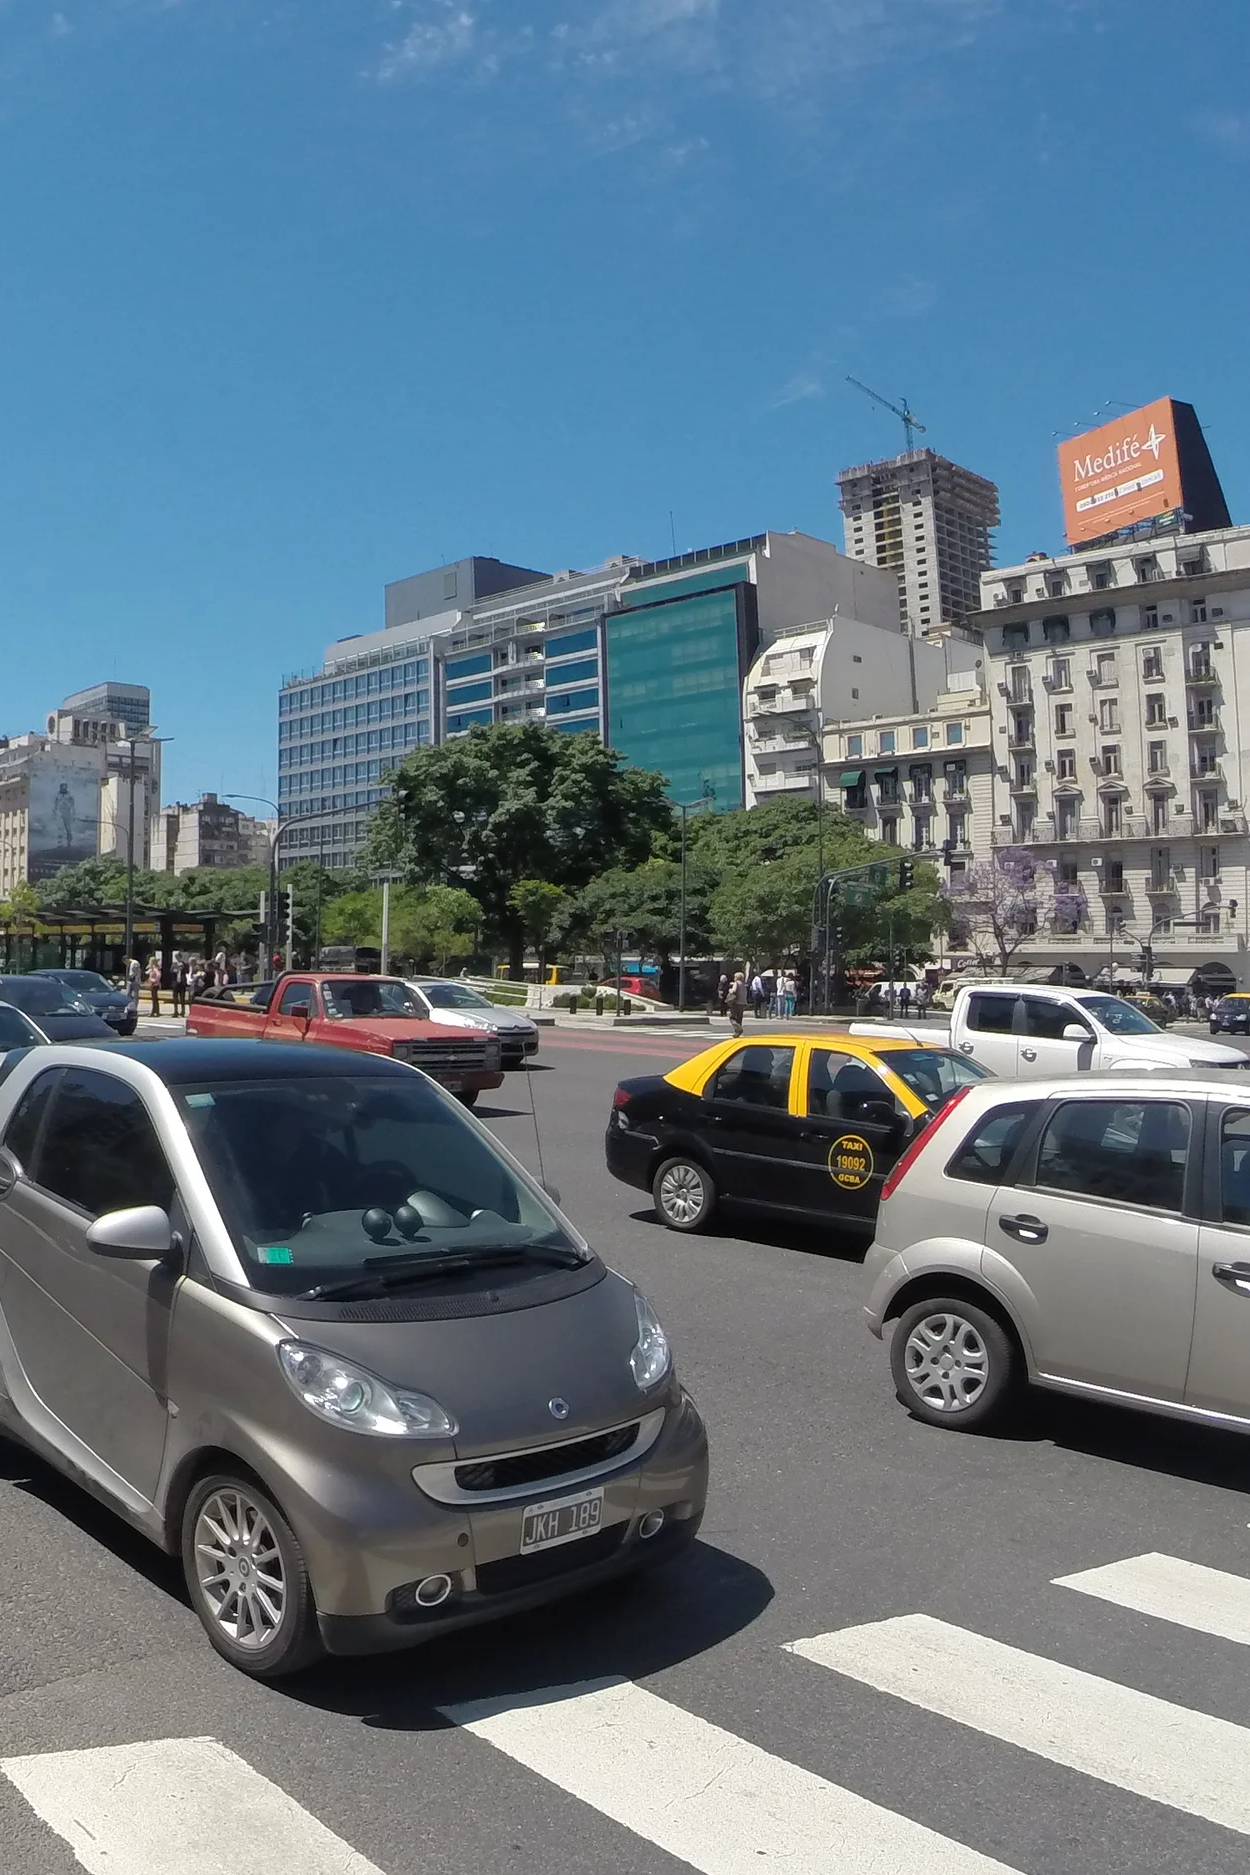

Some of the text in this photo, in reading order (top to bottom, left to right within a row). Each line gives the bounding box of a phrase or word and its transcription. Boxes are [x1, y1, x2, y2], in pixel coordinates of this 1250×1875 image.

[1073, 434, 1141, 482] Medifé
[841, 1140, 863, 1151] TAXI
[836, 1154, 866, 1171] 19092
[525, 1511, 560, 1544] JKH
[569, 1499, 601, 1531] 189
